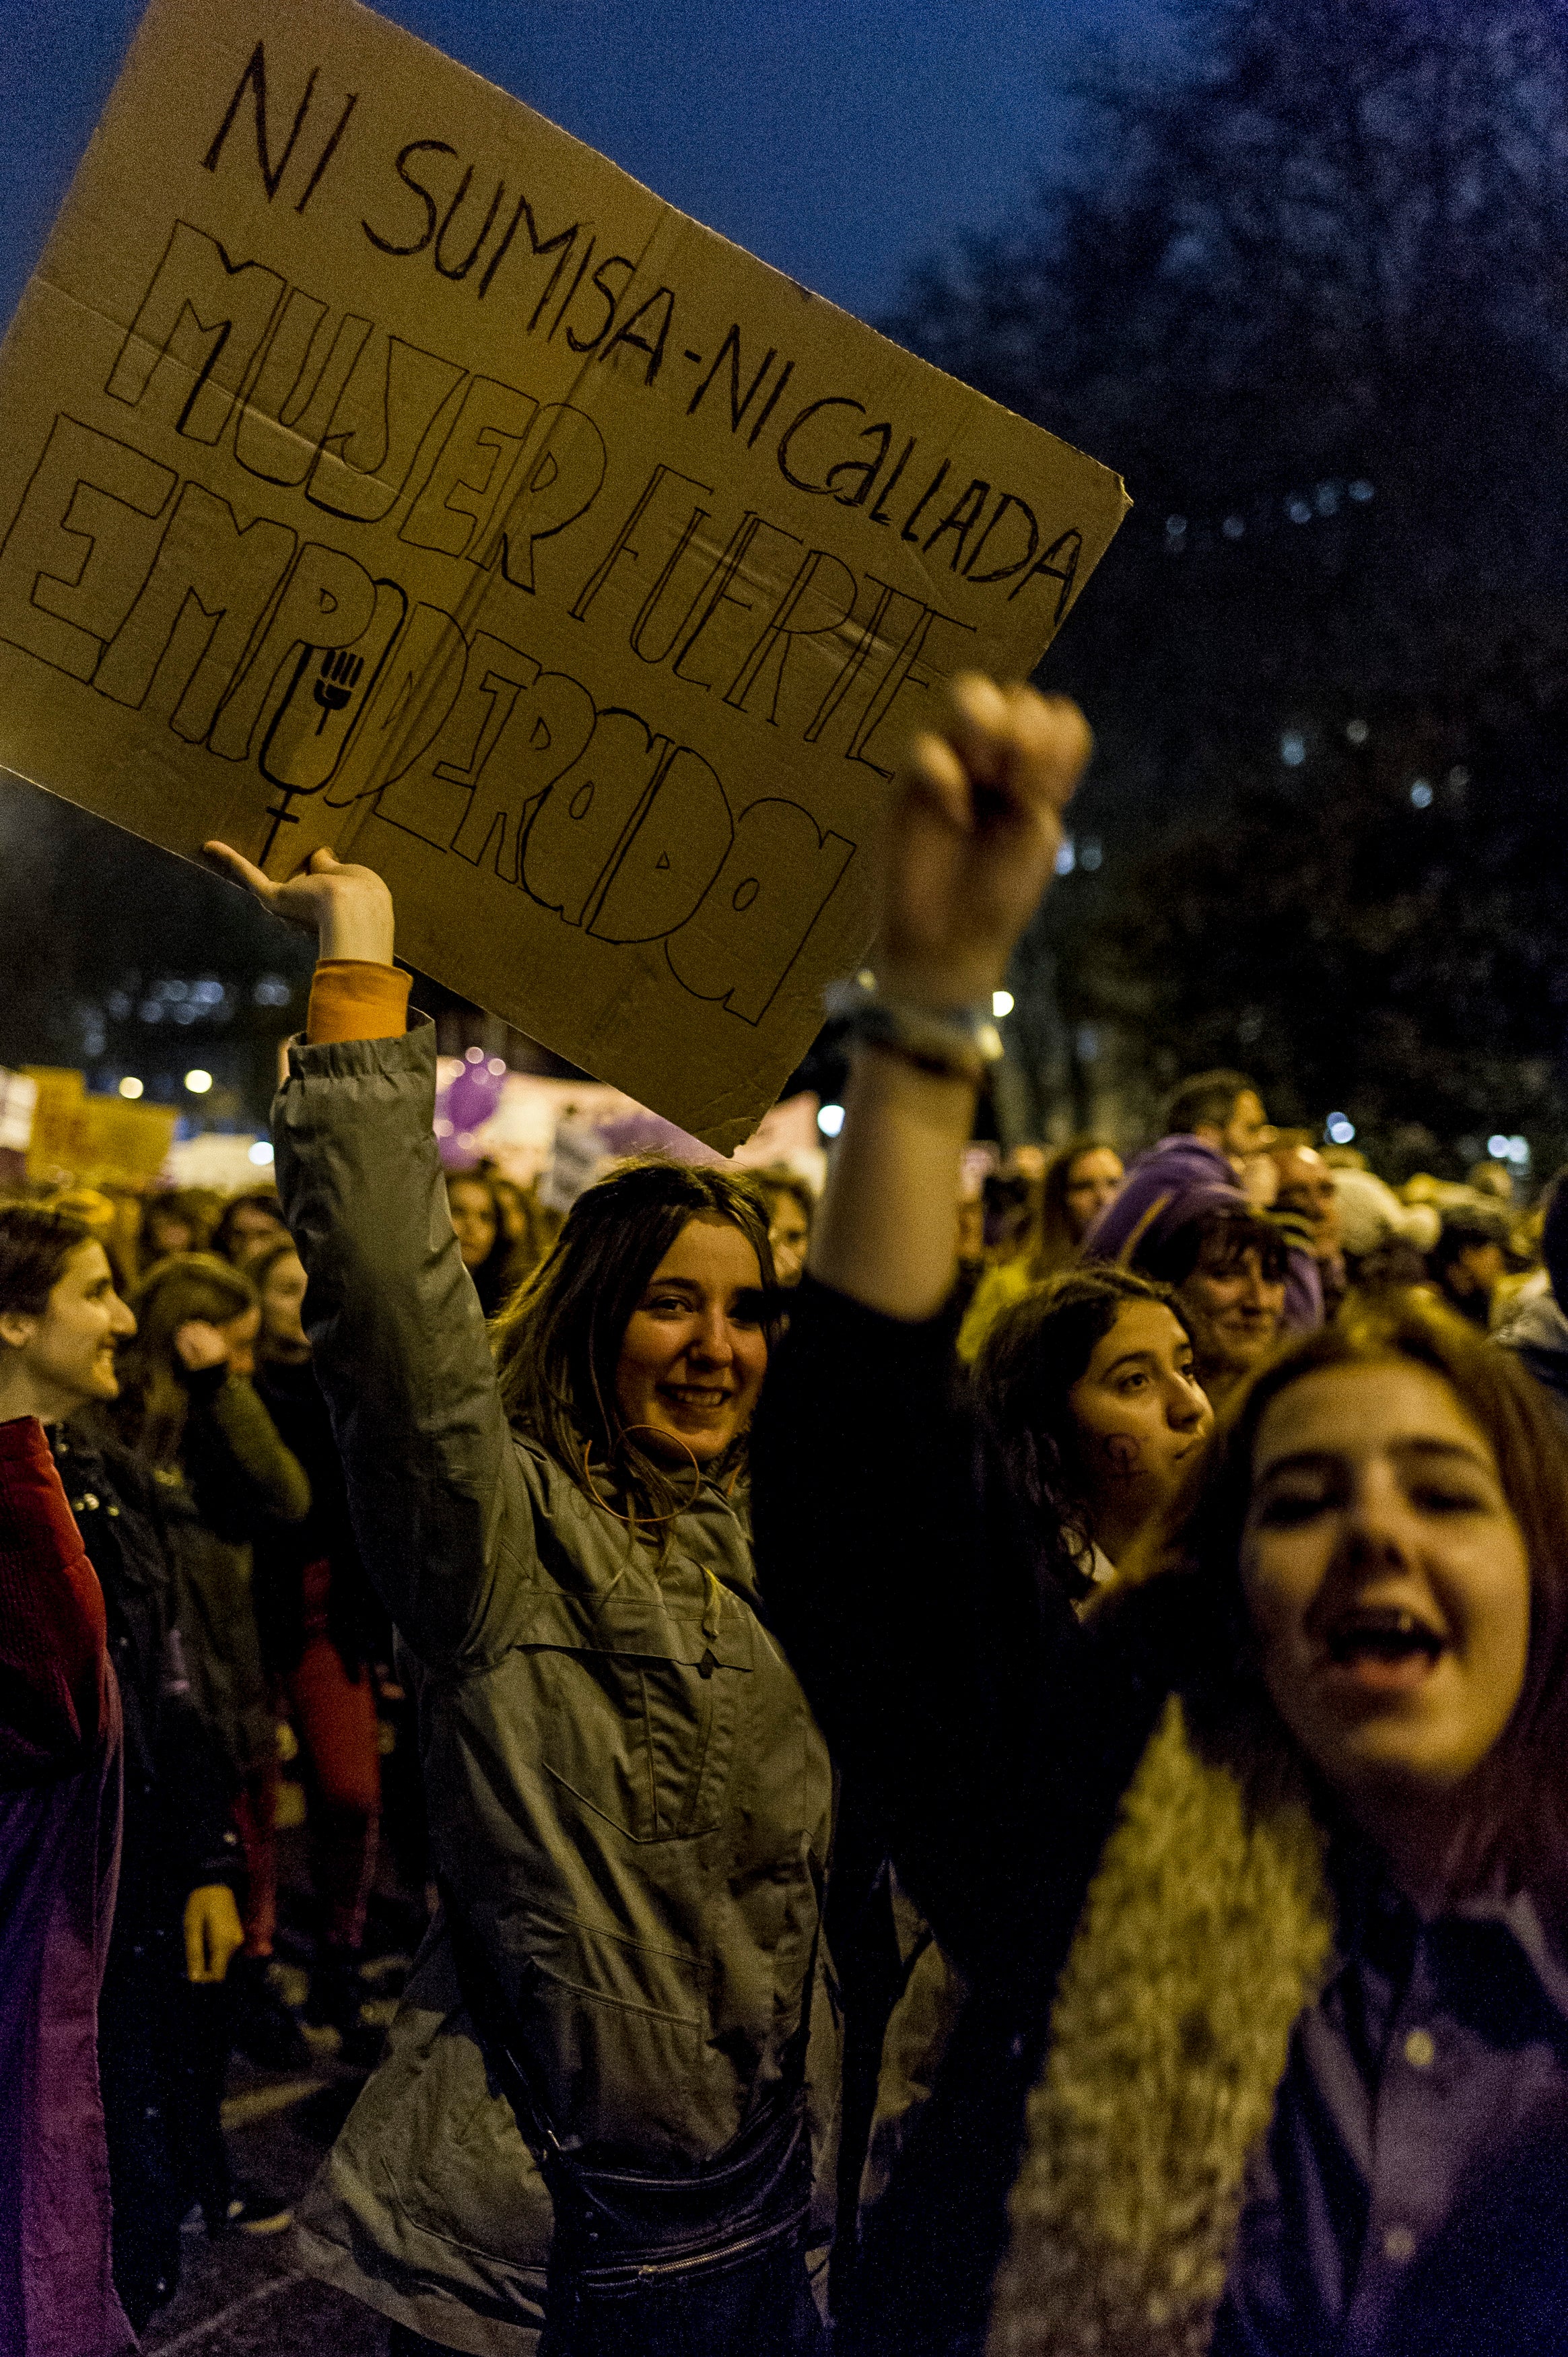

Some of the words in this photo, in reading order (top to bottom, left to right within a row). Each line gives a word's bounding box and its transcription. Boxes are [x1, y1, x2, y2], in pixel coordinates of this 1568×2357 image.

[201, 40, 357, 215] NI
[104, 218, 607, 594] MUJER
[568, 463, 978, 783] FUERTE
